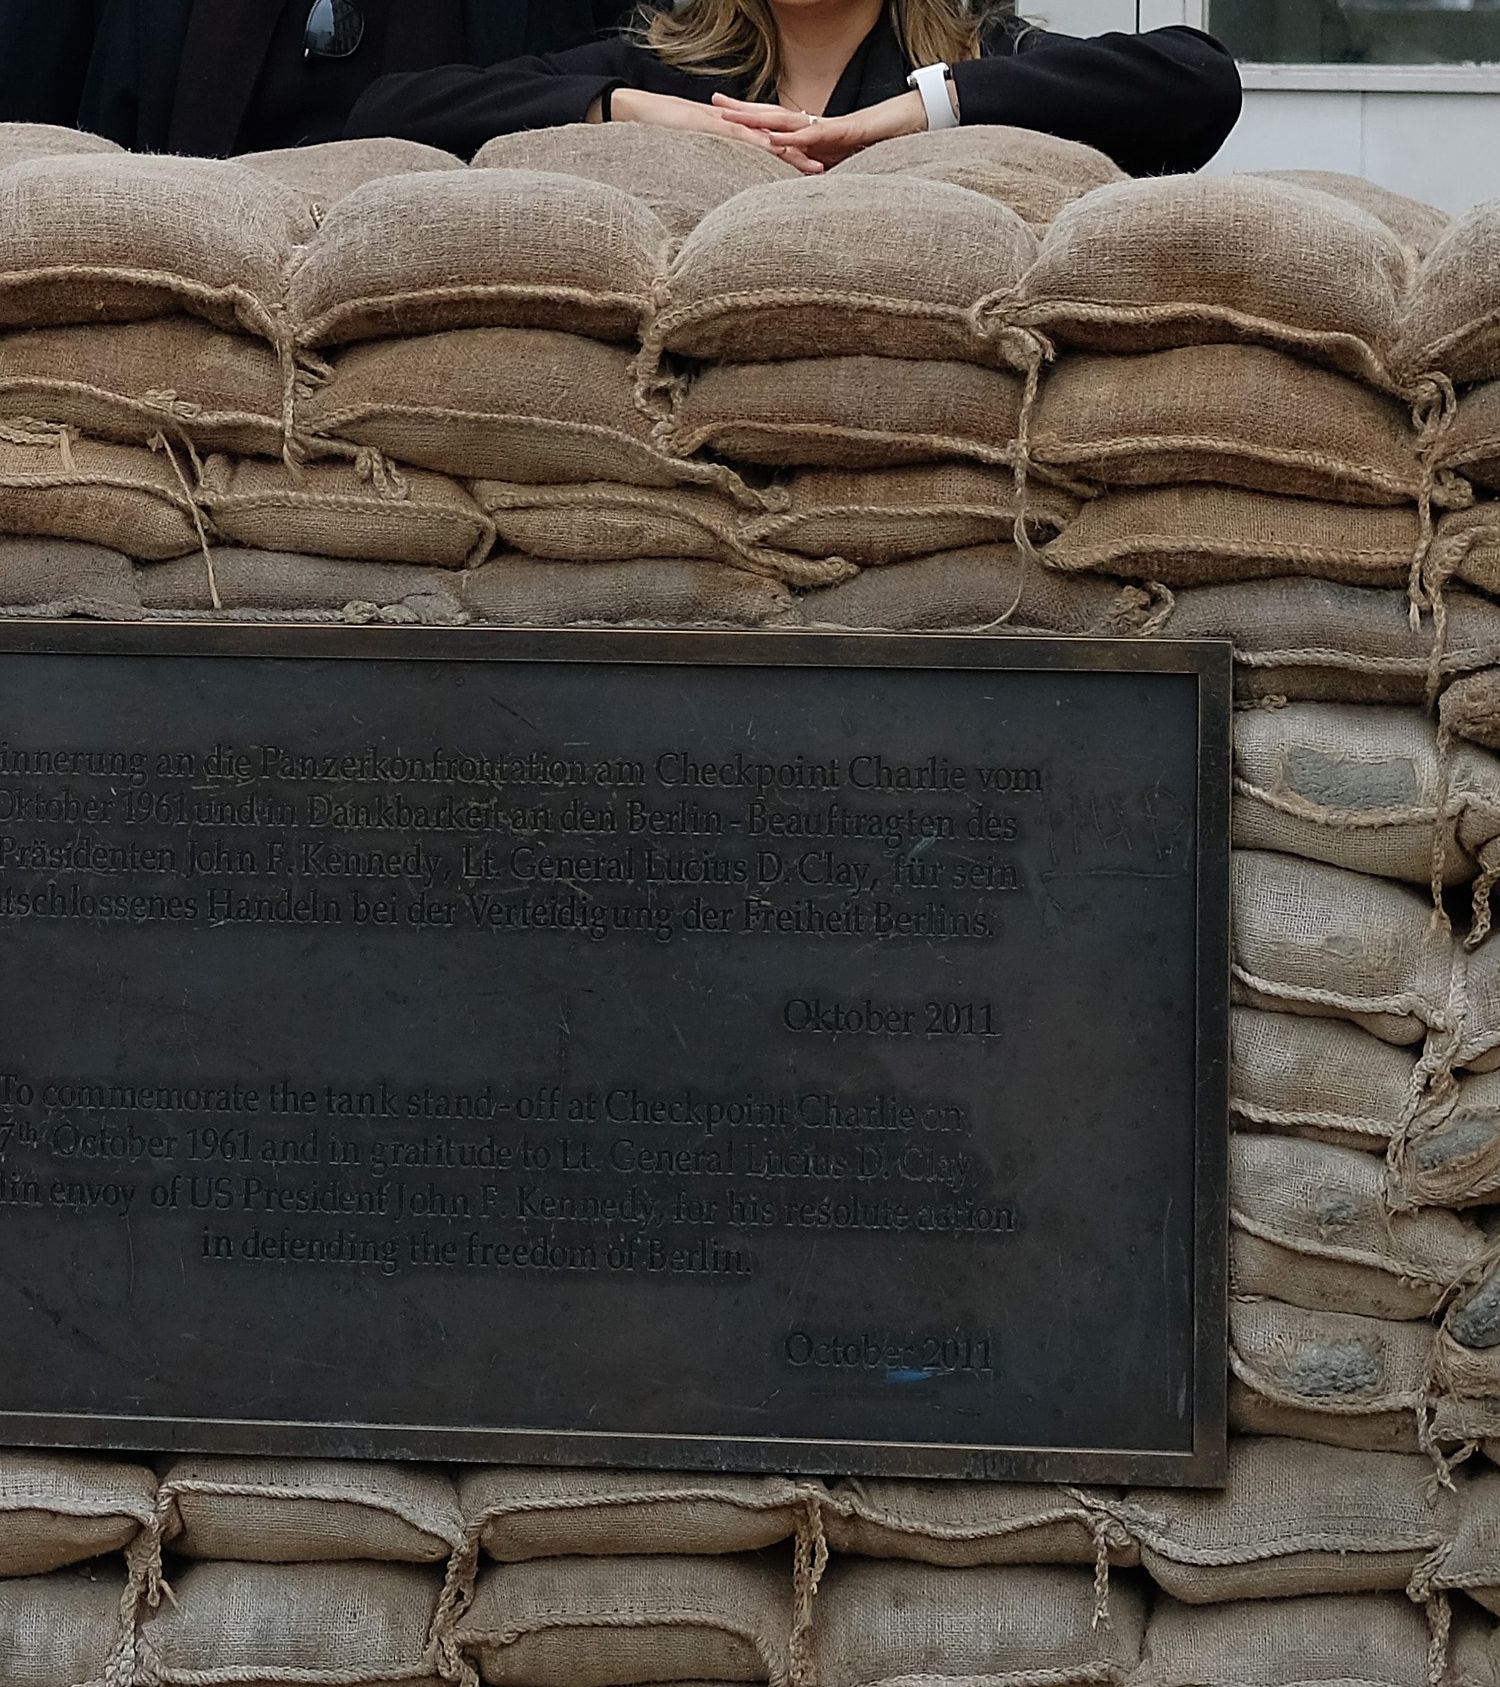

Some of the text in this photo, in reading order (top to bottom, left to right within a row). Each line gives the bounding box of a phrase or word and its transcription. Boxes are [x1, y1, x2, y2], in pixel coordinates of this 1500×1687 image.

[156, 751, 196, 778] an
[203, 743, 253, 780] die
[260, 745, 594, 787] Panzerkonfrontation
[597, 760, 646, 786] am
[655, 752, 840, 797] Checkpoint
[847, 754, 967, 790] Charlie
[974, 766, 1043, 791] vom
[122, 790, 187, 826] 1961
[197, 791, 253, 827] und
[260, 793, 297, 827] in
[306, 794, 500, 833] Dankbarkeit
[508, 806, 552, 831] an
[559, 799, 617, 832] den
[966, 806, 1018, 841] des
[183, 838, 257, 880] John
[302, 842, 452, 888] Kennedy,
[510, 846, 635, 883] General
[644, 849, 747, 884] Lucius
[755, 851, 789, 885] D.
[798, 851, 881, 896] Clay,
[892, 854, 946, 889] für
[952, 856, 1021, 891] sein
[207, 887, 343, 924] Handeln
[352, 890, 399, 925] bei
[407, 891, 458, 926] der
[467, 894, 674, 944] Verteidigung
[682, 897, 735, 932] der
[743, 899, 866, 935] Freiheit
[783, 998, 999, 1037] Oktober 2011
[41, 1082, 262, 1113] commemorate
[268, 1080, 318, 1113] the
[325, 1085, 399, 1118] tank
[566, 1091, 598, 1122] at
[603, 1090, 789, 1135] Checkpoint
[798, 1092, 916, 1130] Charlie
[52, 1124, 178, 1163] October
[185, 1127, 255, 1163] 1961
[261, 1130, 319, 1166] and
[327, 1133, 361, 1166] in
[369, 1135, 514, 1178] gratitude
[519, 1141, 552, 1172] to
[608, 1139, 735, 1177] General
[743, 1142, 845, 1181] Lucius
[49, 1179, 137, 1217] envoy
[149, 1175, 187, 1210] of
[189, 1177, 236, 1211] US
[242, 1178, 390, 1215] President
[399, 1182, 470, 1221] John
[516, 1185, 667, 1230] Kennedy,
[672, 1189, 721, 1226] for
[726, 1188, 775, 1227] his
[783, 1192, 908, 1231] resolute
[913, 1197, 1018, 1233] action
[201, 1225, 753, 1276] in defending the freedom of Berlin.
[784, 1331, 996, 1372] October 2011
